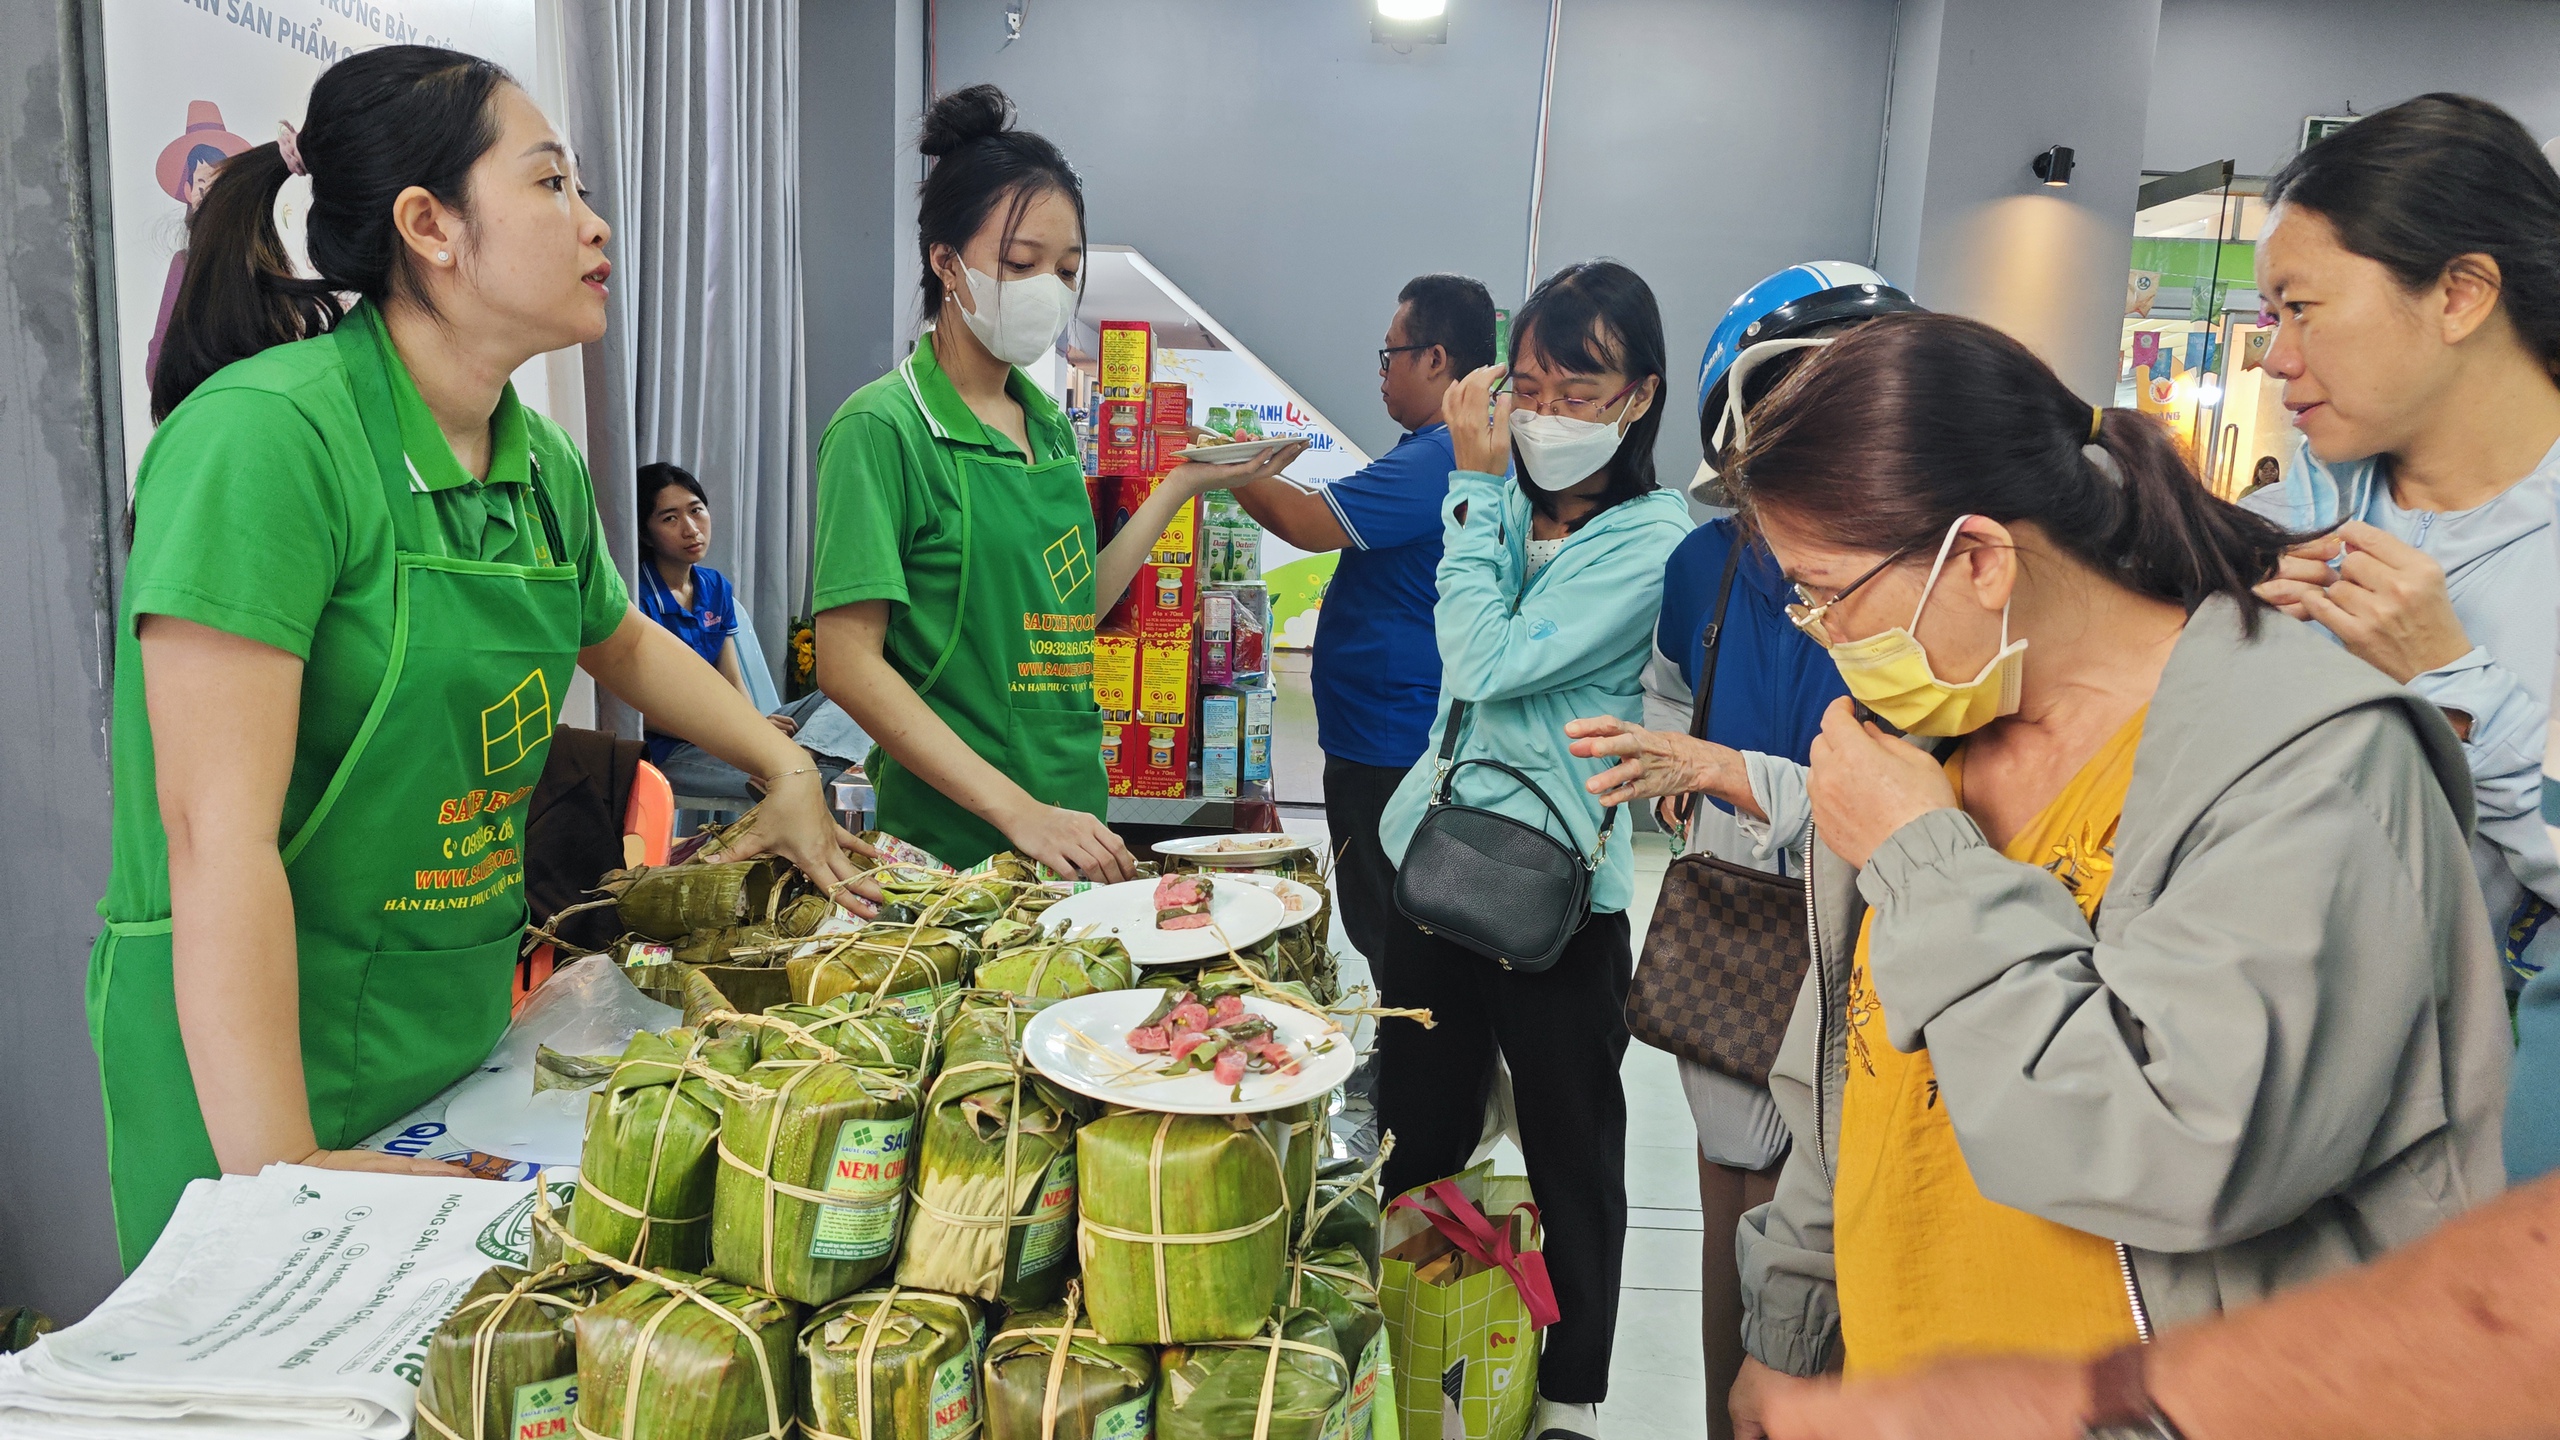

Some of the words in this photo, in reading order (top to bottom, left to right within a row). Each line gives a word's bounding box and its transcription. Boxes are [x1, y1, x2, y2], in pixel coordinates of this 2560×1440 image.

[384, 896, 421, 911] HÂN
[423, 896, 468, 911] HẠNH
[836, 1160, 879, 1181] NEM
[1041, 1187, 1072, 1208] NEM
[429, 1193, 463, 1226] NÔNG
[411, 1229, 439, 1252] SẢN
[365, 1284, 395, 1307] SẢN
[935, 1396, 969, 1428] NEM
[520, 1417, 566, 1440] NEM
